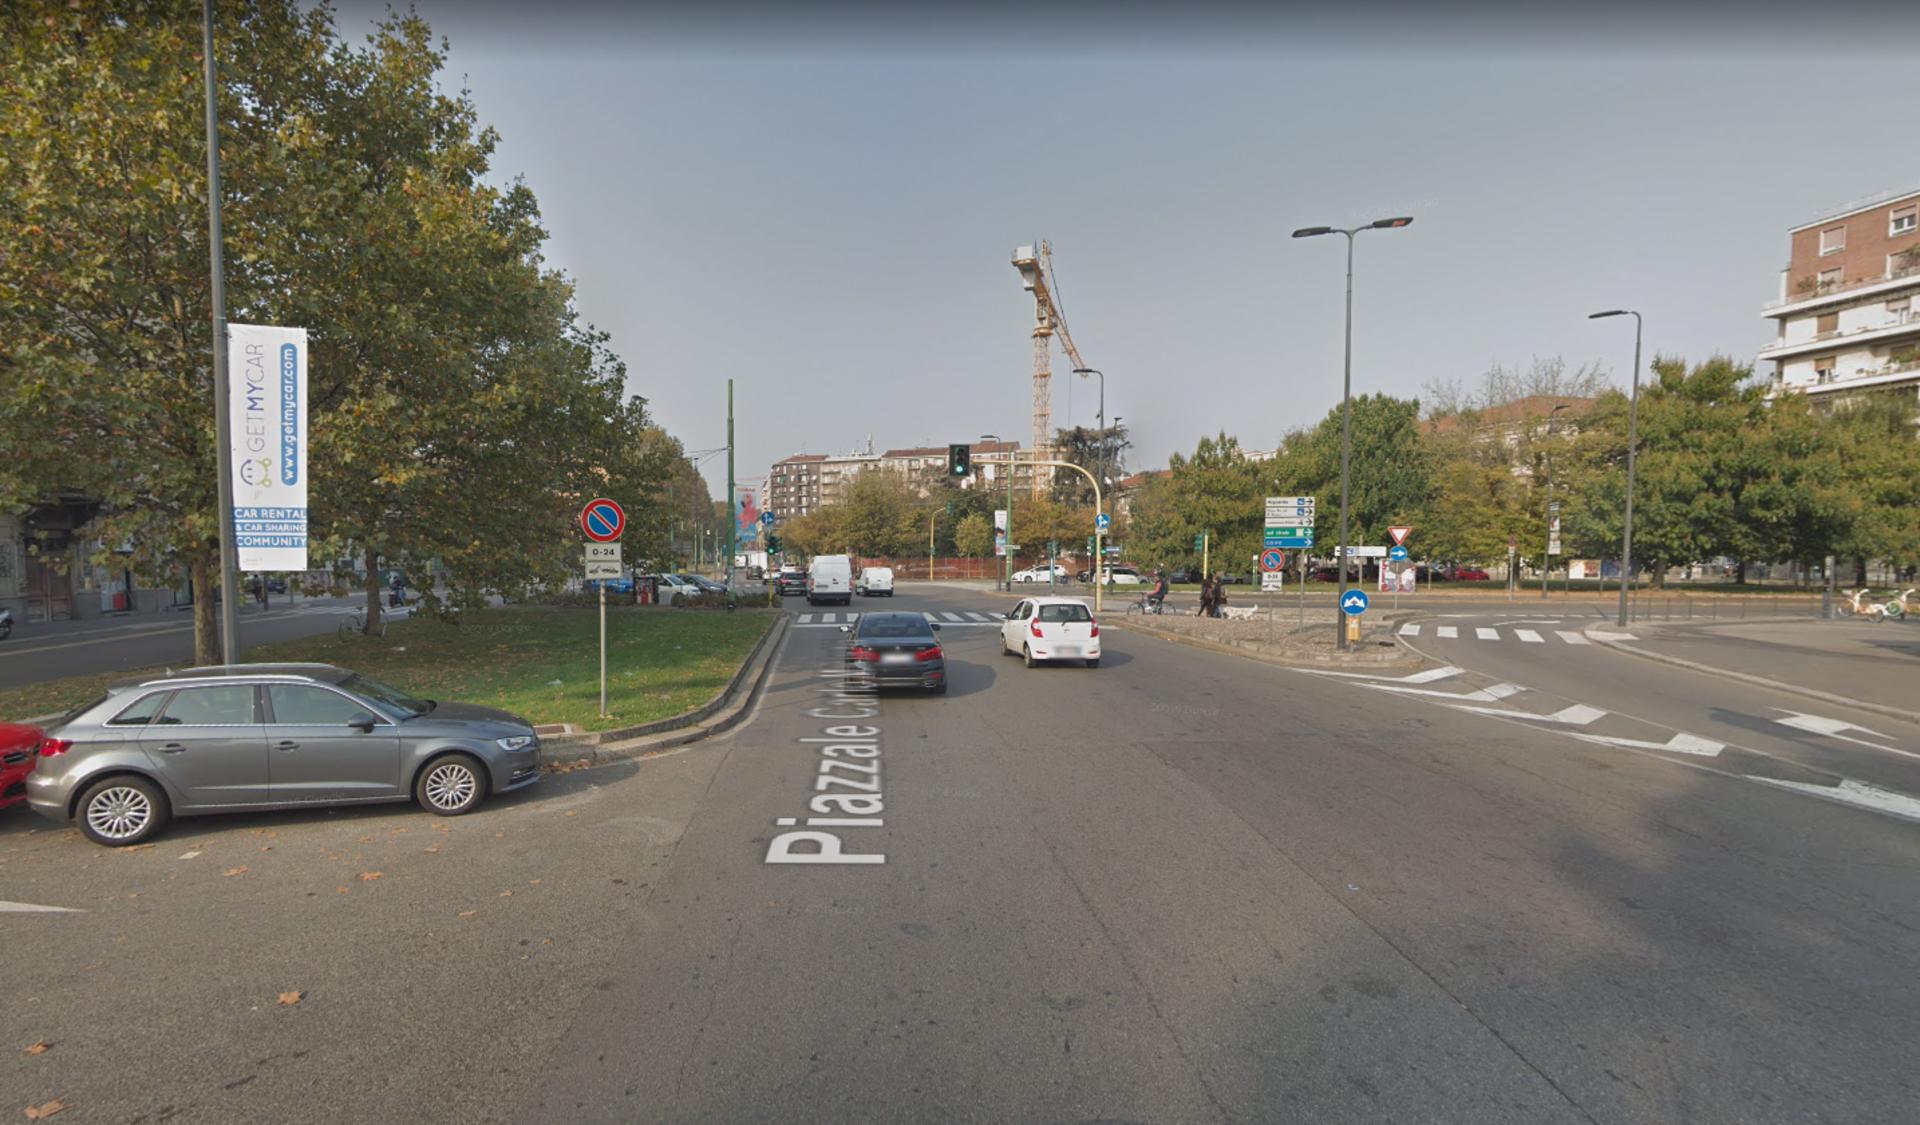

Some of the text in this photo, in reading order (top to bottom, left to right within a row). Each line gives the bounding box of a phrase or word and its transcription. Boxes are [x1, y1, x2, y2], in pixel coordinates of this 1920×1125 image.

[246, 343, 265, 452] GETMYCAR
[281, 348, 297, 480] www.getmycar.com
[234, 508, 307, 519] CAR RENTAL
[236, 523, 307, 532] & CAR SHARING
[236, 536, 307, 546] COMMUNITY
[592, 548, 615, 556] 0-24
